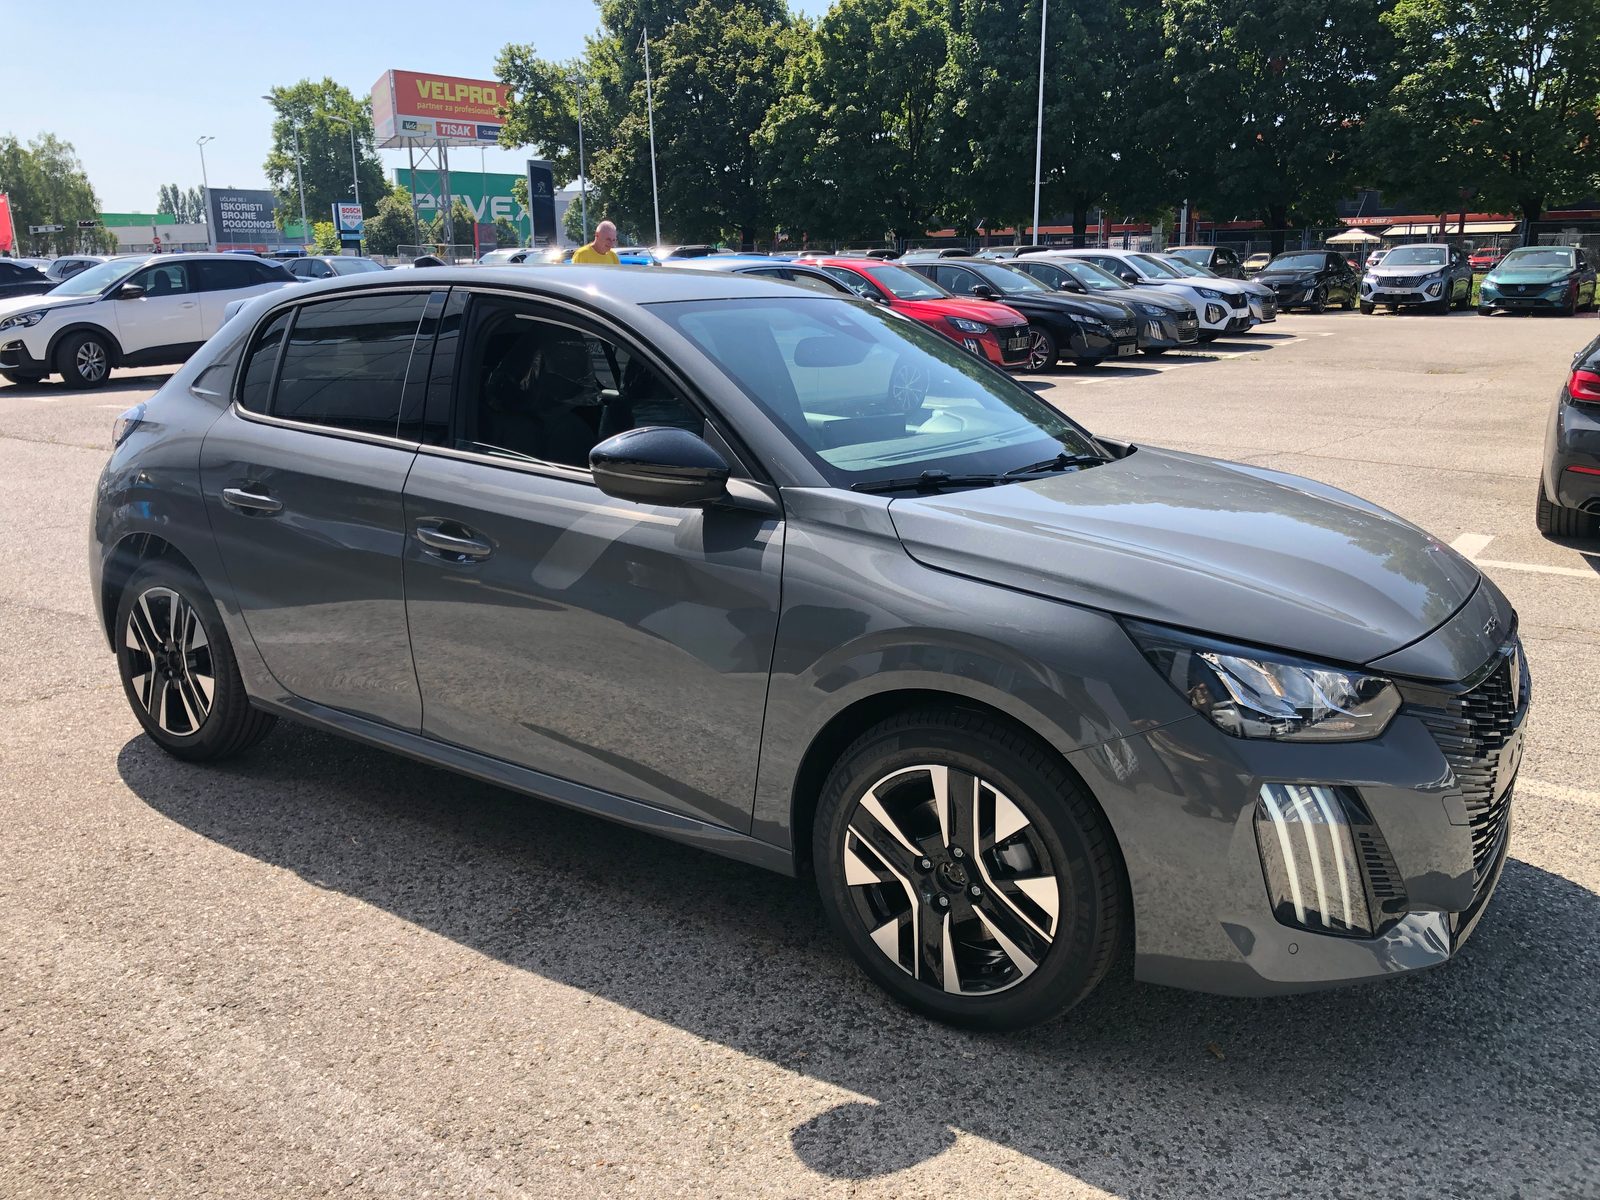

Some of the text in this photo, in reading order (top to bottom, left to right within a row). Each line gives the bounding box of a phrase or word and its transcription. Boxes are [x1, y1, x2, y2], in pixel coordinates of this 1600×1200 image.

[416, 80, 496, 105] VELPRO
[417, 102, 443, 110] partner
[454, 105, 497, 116] profesionalc
[441, 124, 471, 136] TISAK
[220, 202, 263, 211] ISKORISTI
[221, 211, 257, 220] BROJNE
[222, 220, 276, 229] POGODNOST
